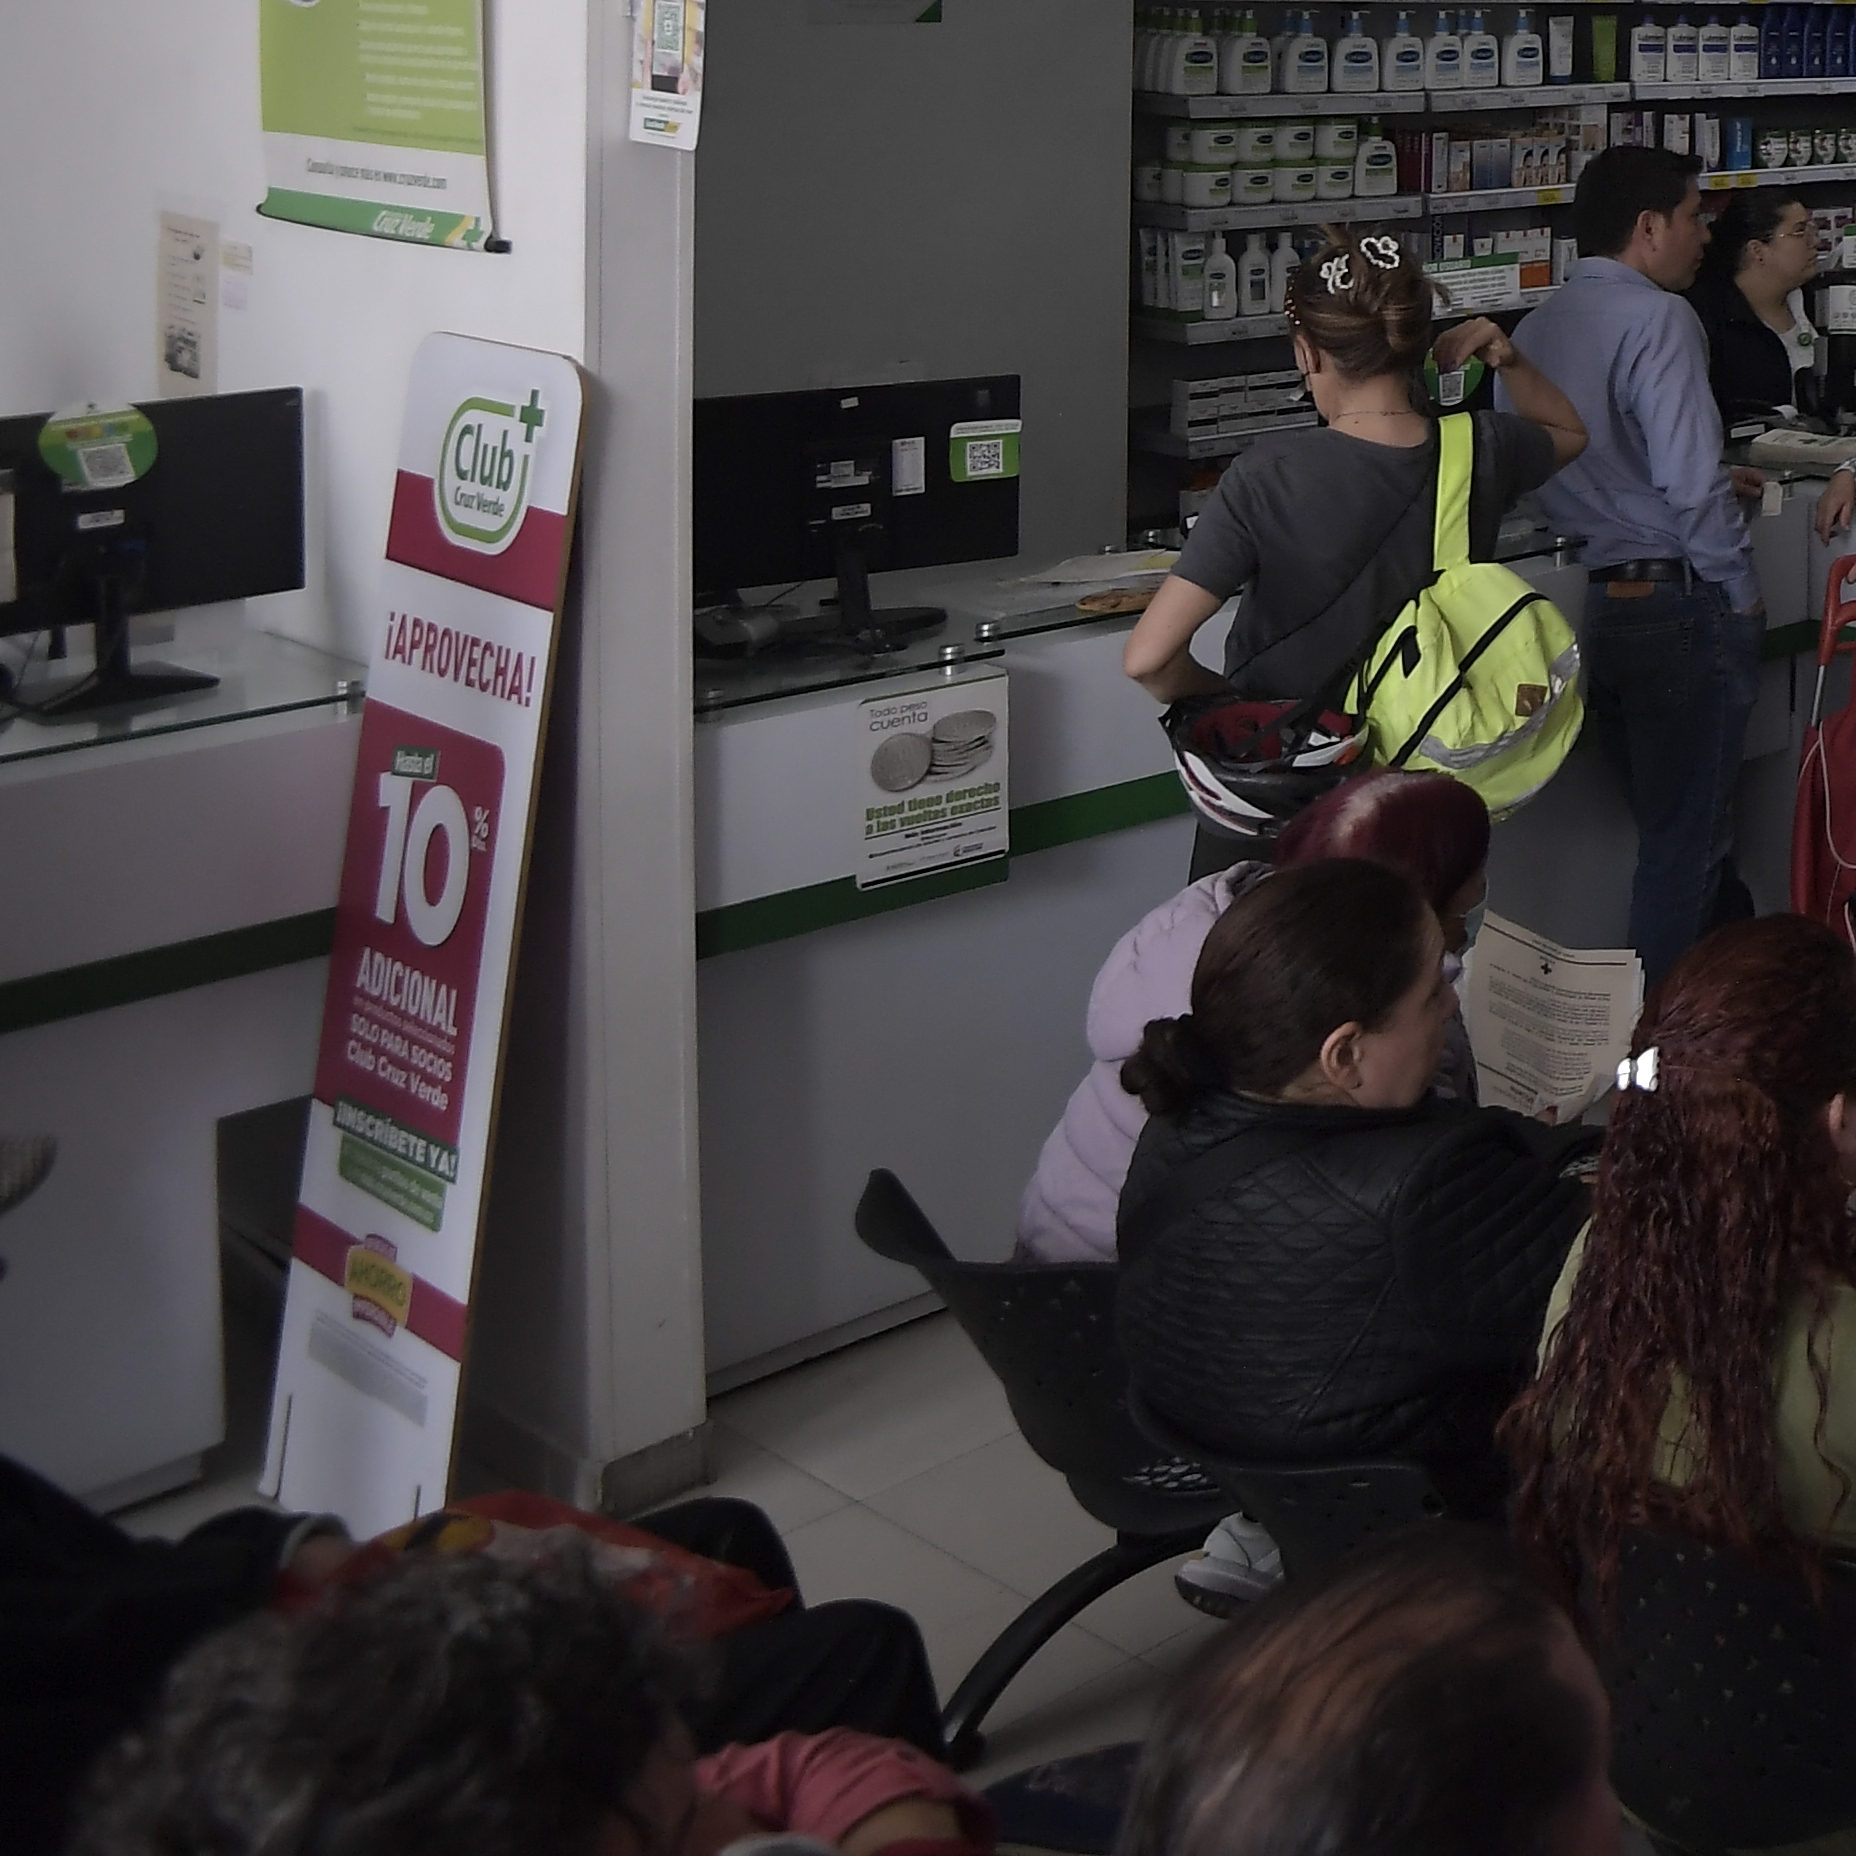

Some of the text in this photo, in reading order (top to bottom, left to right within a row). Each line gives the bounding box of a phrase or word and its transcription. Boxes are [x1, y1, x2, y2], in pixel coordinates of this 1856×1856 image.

[373, 209, 435, 240] Cruz Verde
[454, 422, 514, 493] Club
[454, 486, 505, 517] Cruz Verde
[385, 611, 537, 707] ¡APROVECHA!
[869, 711, 928, 732] cuenta
[870, 701, 927, 719] Todo peso
[866, 781, 1001, 822] Usted tiene derecho
[866, 795, 1000, 836] a las vueltas exactas
[356, 946, 458, 1037] ADICIONAL
[350, 1012, 453, 1083] SOLO PARA SOCIOS
[347, 1040, 449, 1111] Club Cruz Verde
